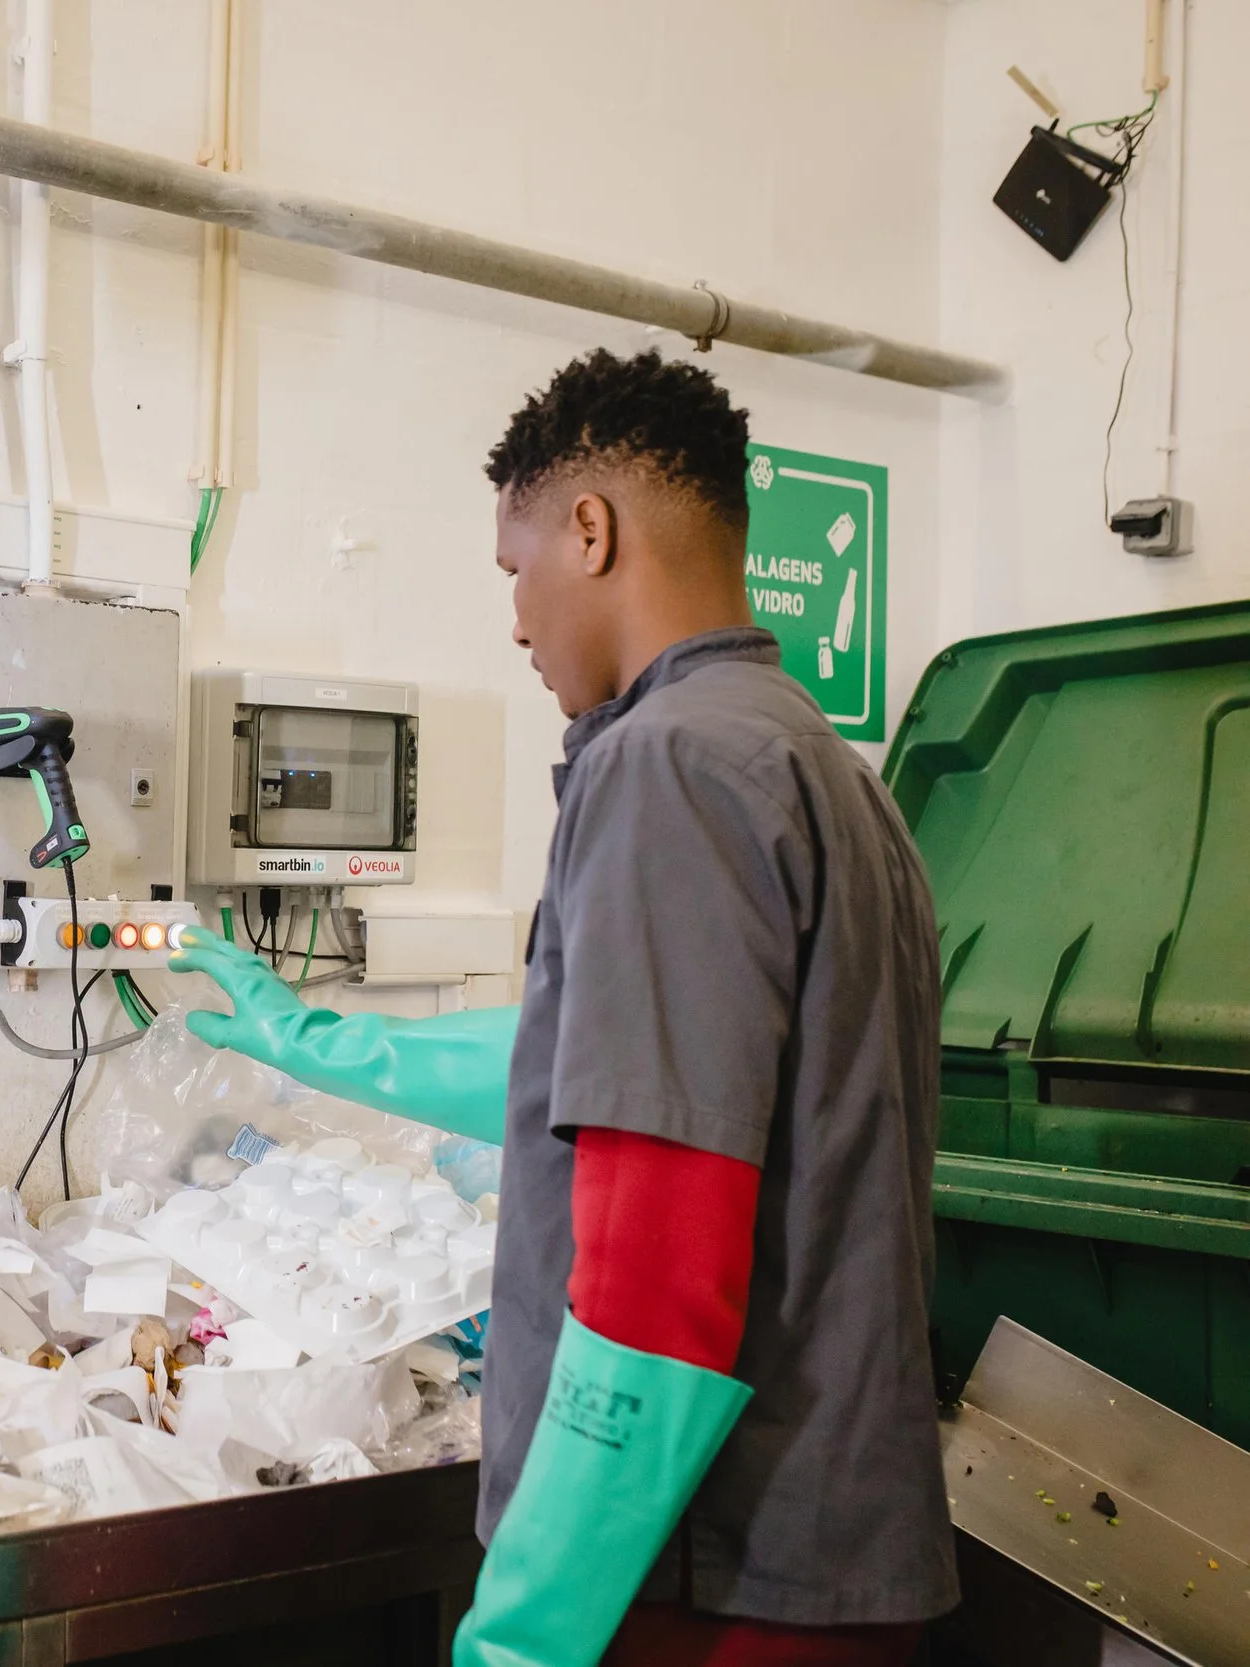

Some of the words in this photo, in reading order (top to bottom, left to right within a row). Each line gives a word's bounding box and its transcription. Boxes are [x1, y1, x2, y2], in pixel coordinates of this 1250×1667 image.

[745, 552, 822, 586] ALAGENS
[752, 588, 805, 617] VIDRO
[259, 858, 324, 872] smartbin.io
[364, 861, 400, 873] VEOLIA
